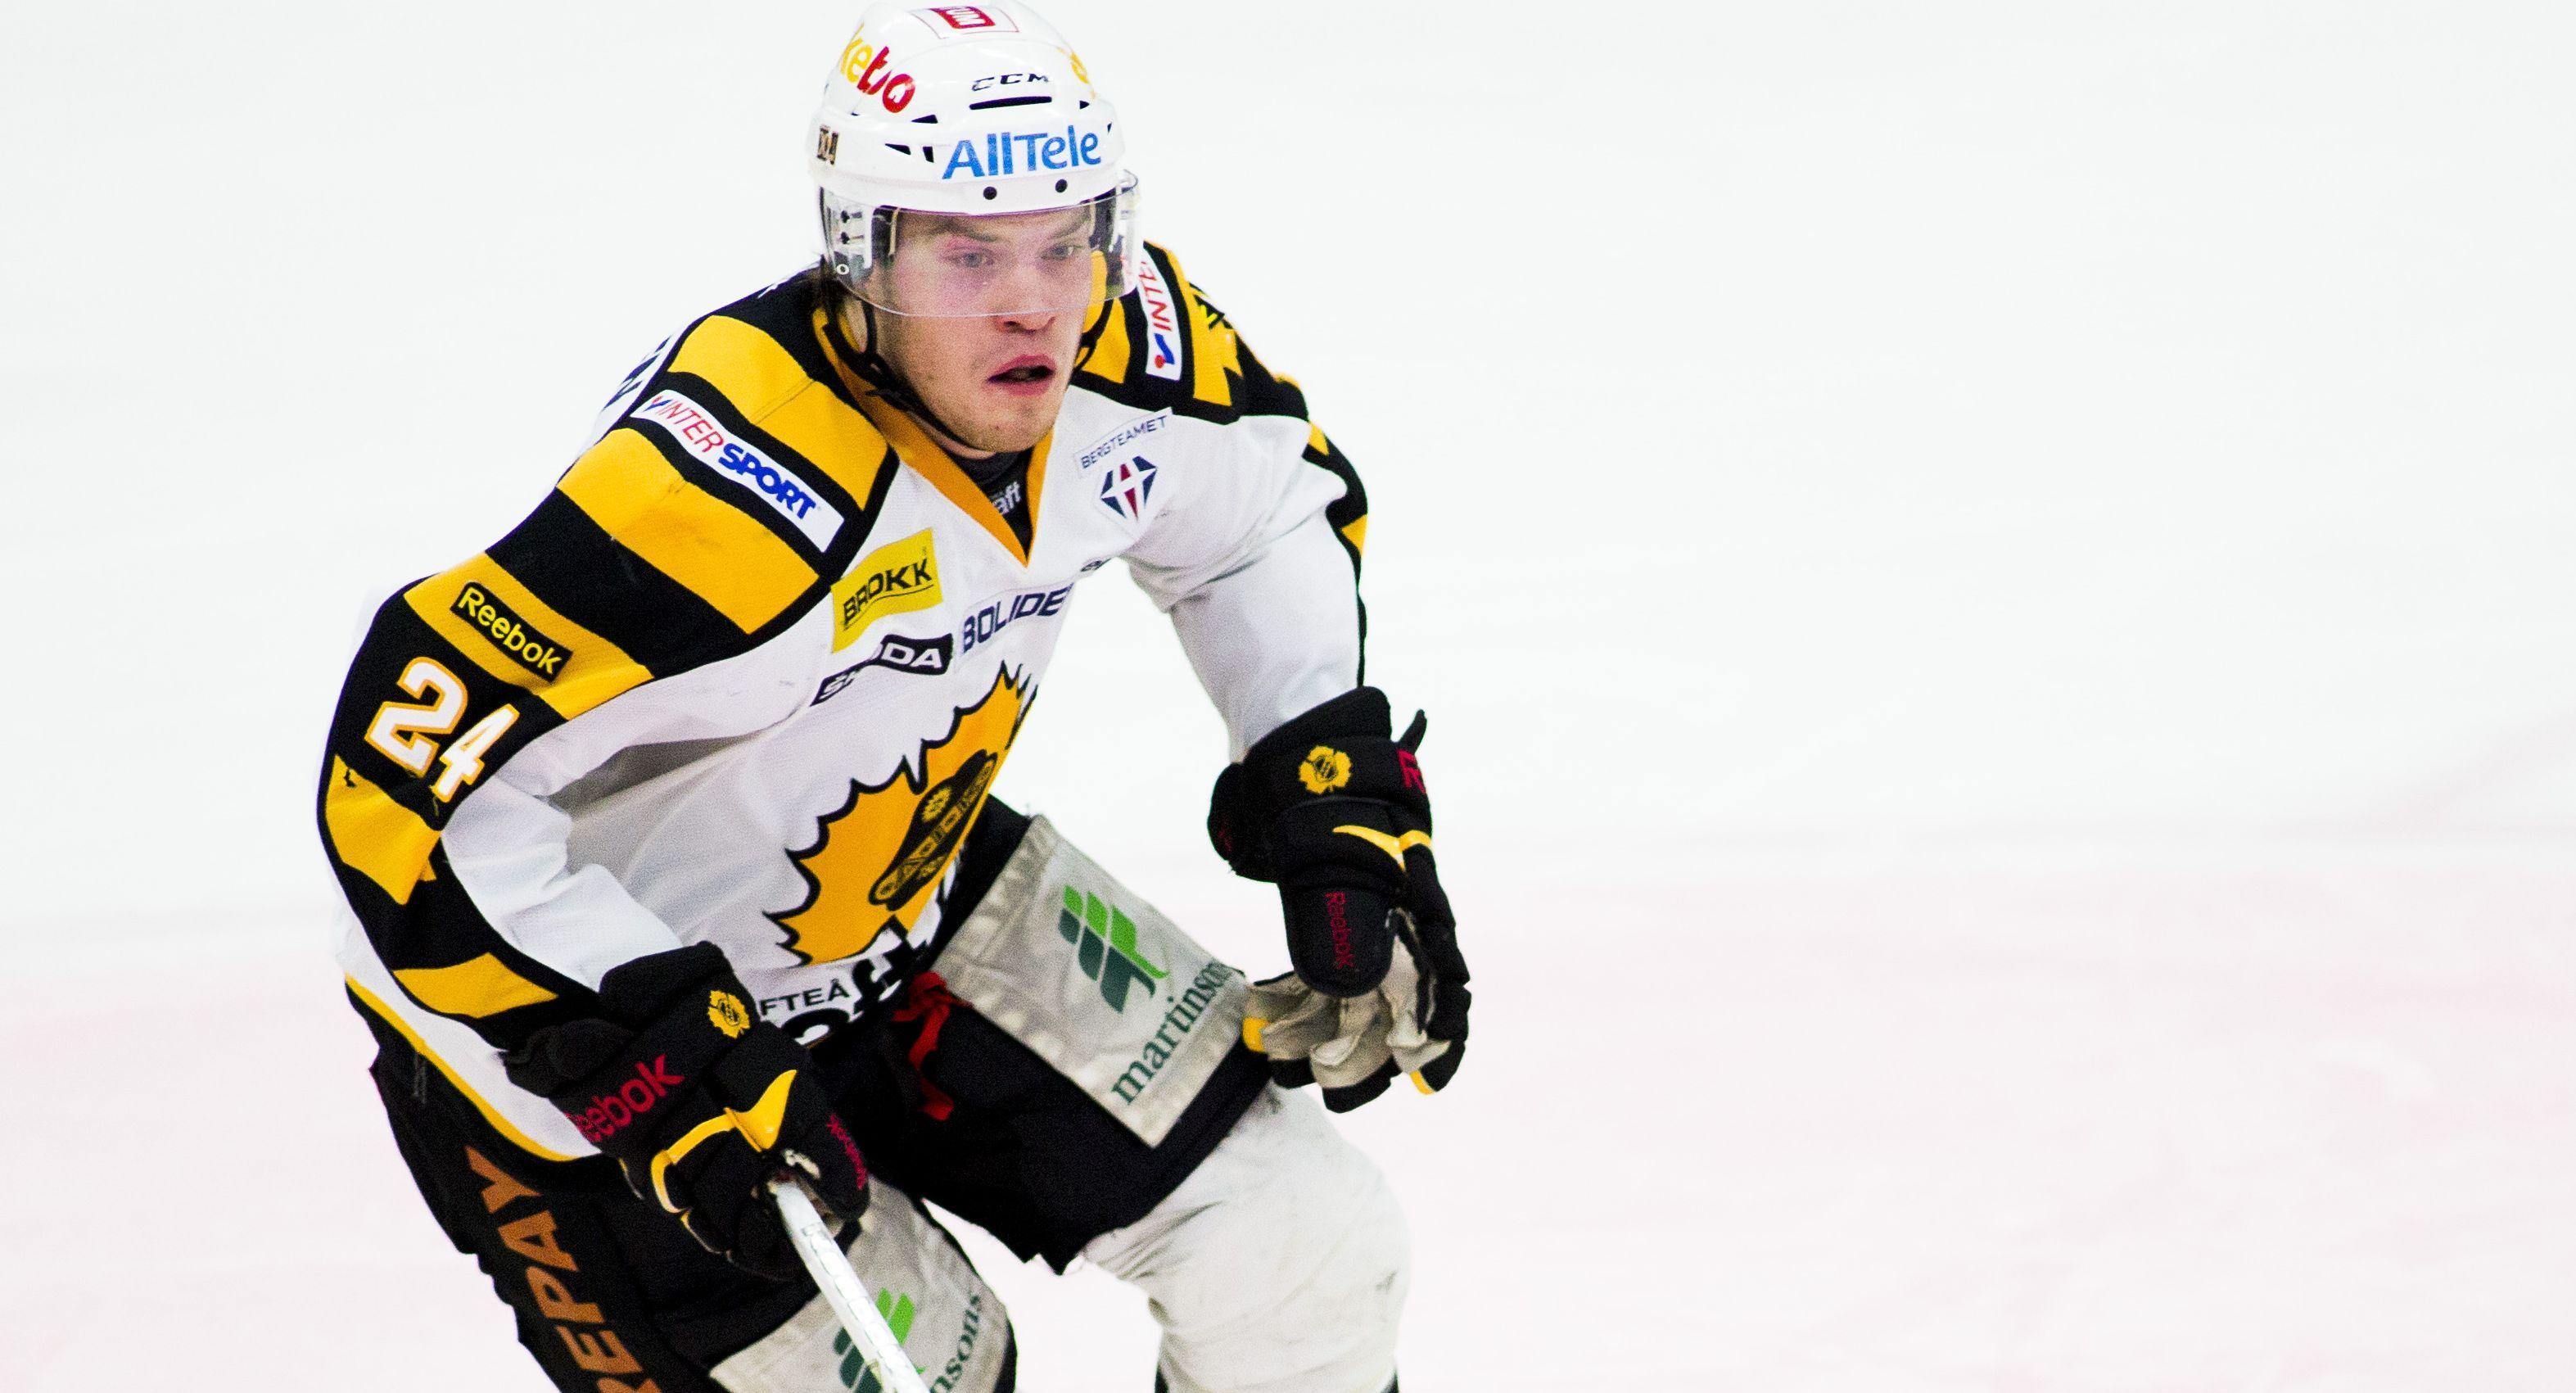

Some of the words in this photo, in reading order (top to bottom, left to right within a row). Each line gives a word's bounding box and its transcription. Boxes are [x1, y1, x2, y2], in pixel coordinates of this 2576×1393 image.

[971, 74, 1049, 92] CCM
[942, 124, 1101, 179] AllTele
[459, 586, 563, 675] Reebok
[843, 558, 933, 627] BROKK
[364, 656, 520, 803] 24
[565, 1053, 685, 1142] eebok
